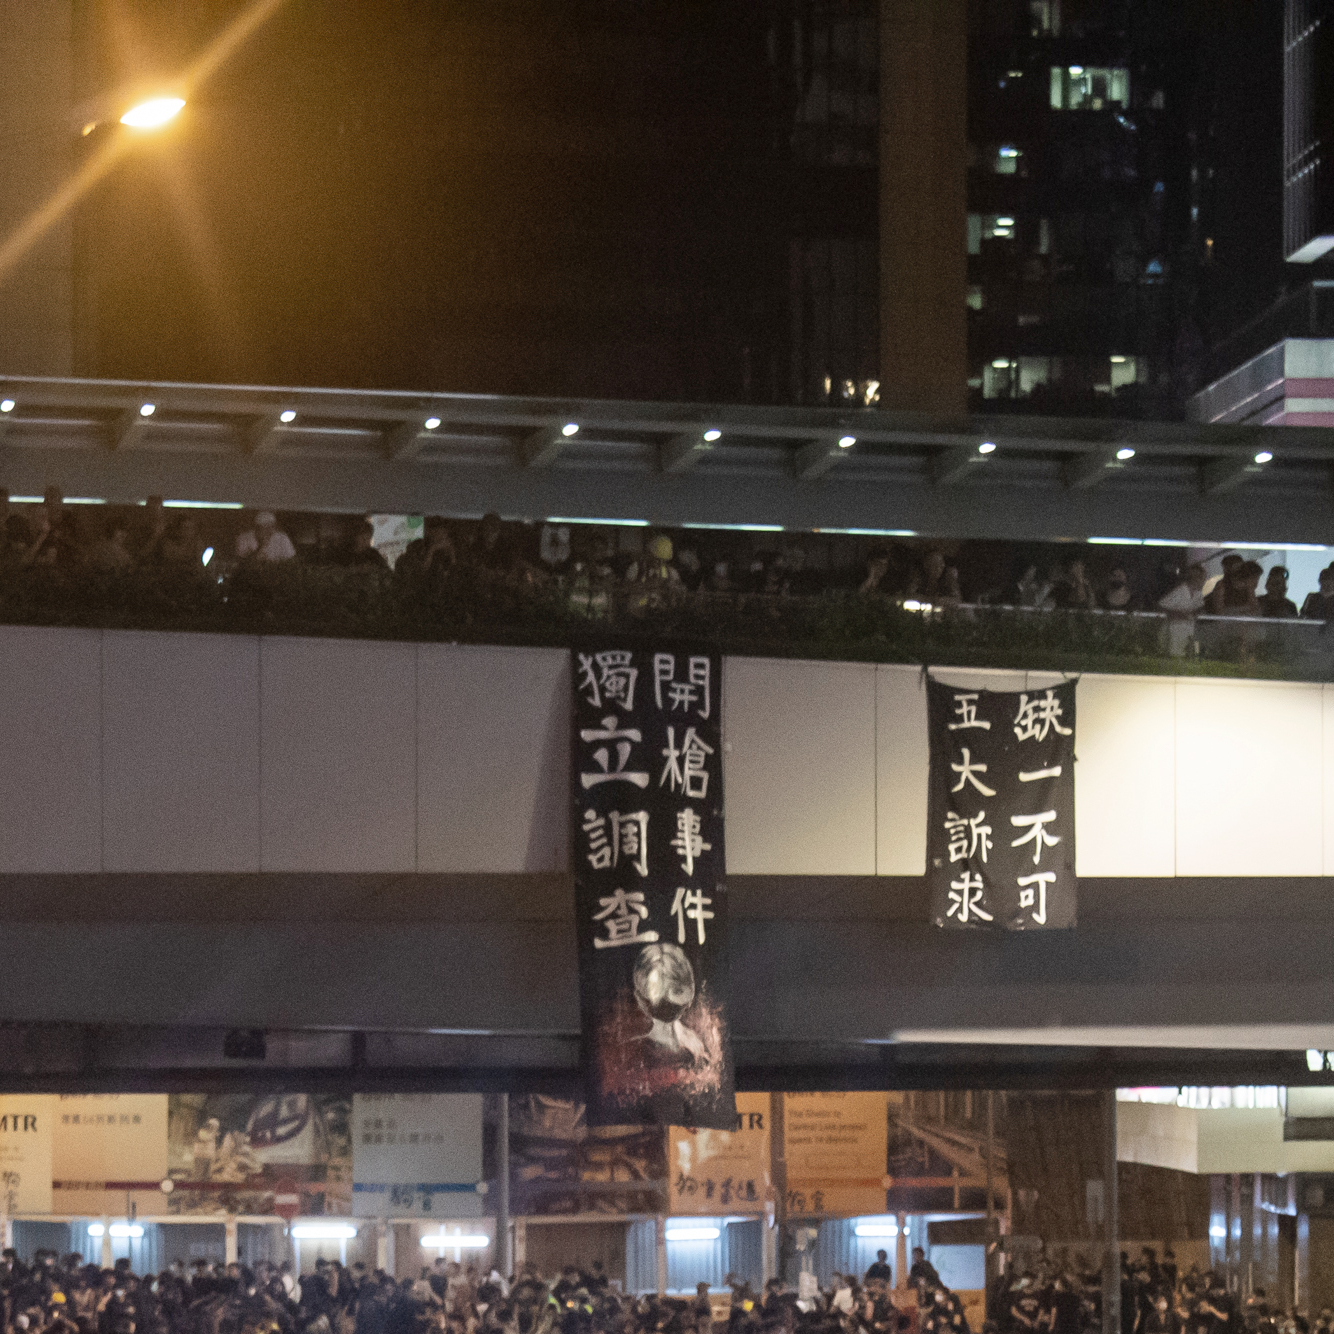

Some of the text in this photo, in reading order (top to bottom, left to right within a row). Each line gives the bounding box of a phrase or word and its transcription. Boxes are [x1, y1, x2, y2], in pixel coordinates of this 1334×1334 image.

[578, 650, 659, 948] 獨立調查
[653, 653, 714, 945] 開槍事件
[944, 693, 996, 923] 五大訴求
[1012, 691, 1072, 925] 缺一不可
[737, 1112, 764, 1130] TR
